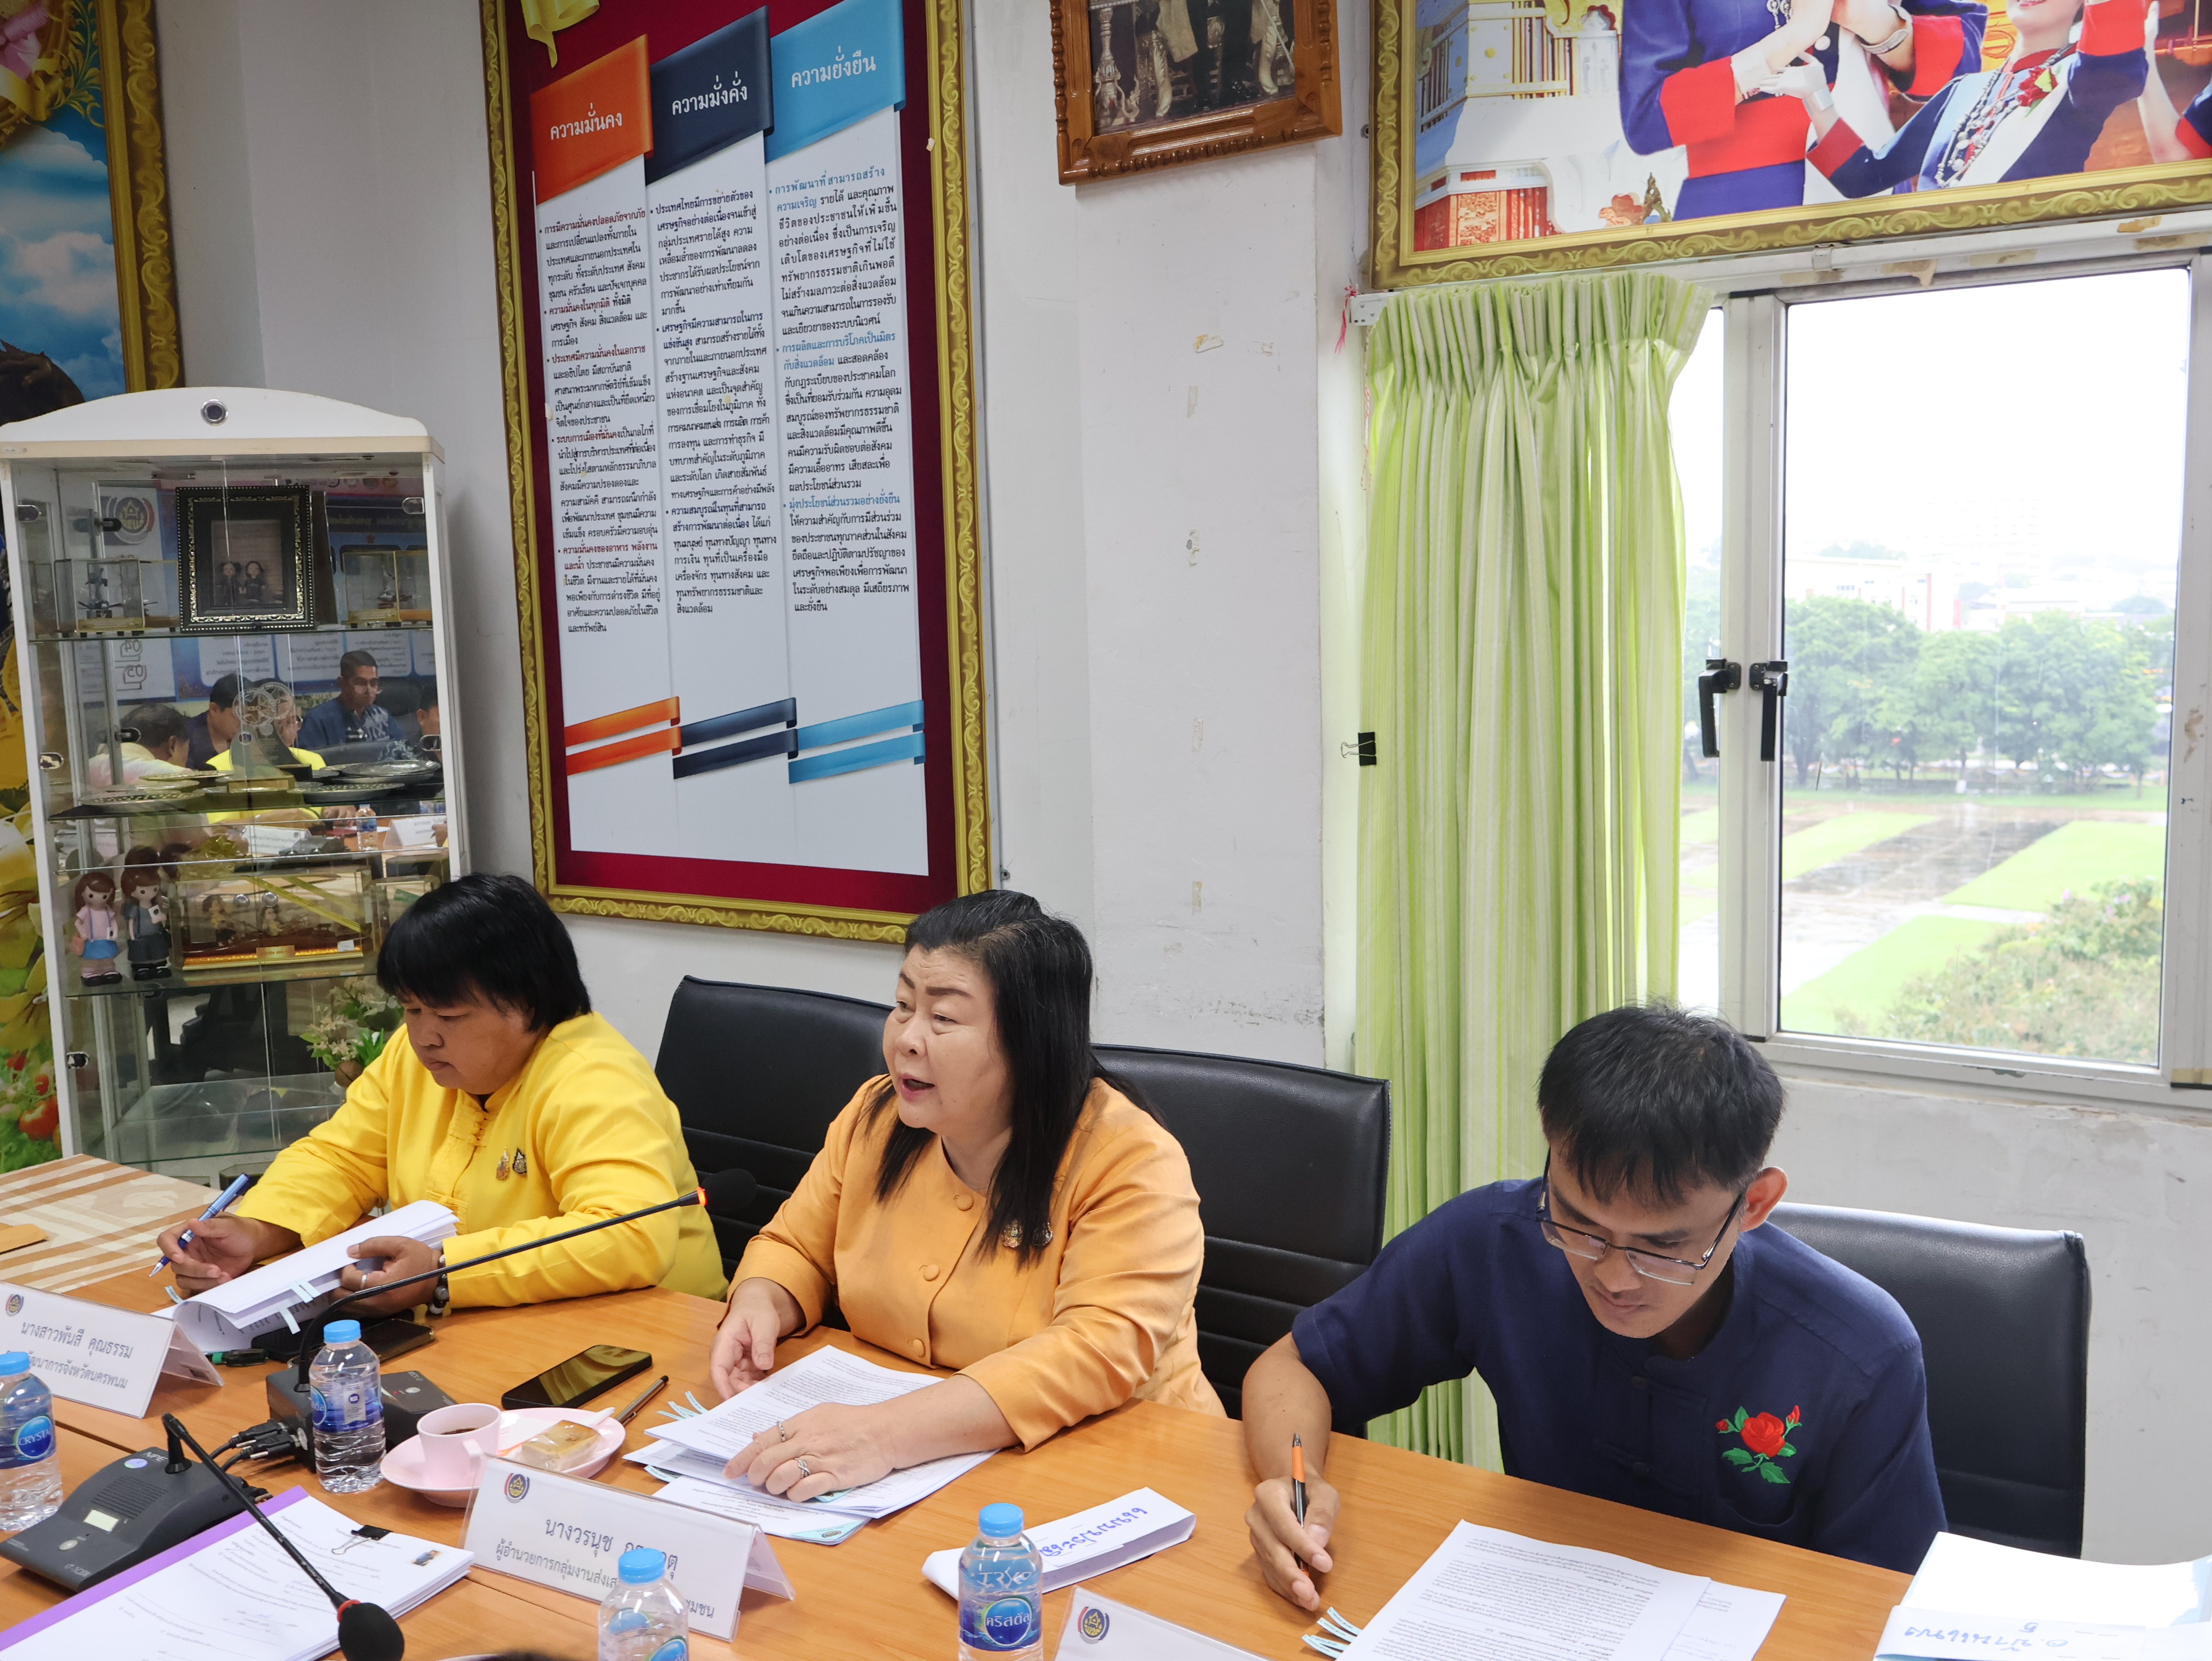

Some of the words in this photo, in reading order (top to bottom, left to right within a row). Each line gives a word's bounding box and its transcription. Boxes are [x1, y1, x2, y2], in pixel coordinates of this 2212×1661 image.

[792, 46, 876, 88] ความยั่งยืน
[673, 71, 747, 115] ความมั่งคั่ง
[551, 103, 622, 140] ความมั่นคง
[777, 196, 816, 212] ความเจริญ
[820, 189, 844, 204] รายได้
[848, 186, 893, 201] และคุณภาพ
[734, 226, 752, 236] ความ
[779, 227, 828, 247] อย่างต่อเนื่อง
[548, 269, 573, 286] ทุกระดับ
[575, 264, 624, 278] ทั้งระดับประเทศ
[627, 260, 645, 271] สังคม
[549, 290, 567, 302] ชุมชน
[569, 283, 595, 296] ครัวเรือน
[598, 278, 646, 292] และปัจเจกบุคคล
[612, 292, 631, 306] ทั้งมิติ
[662, 299, 685, 316] มากขึ้น
[551, 318, 577, 332] เศรษฐกิจ
[580, 317, 596, 327] สังคม
[599, 311, 632, 325] สิ่งแวดล้อม
[552, 335, 578, 347] การเมือง
[663, 337, 692, 350] แข่งขันสูง
[784, 355, 834, 370] กับสิ่งแวดล้อม
[838, 348, 888, 365] และสอดคล้อง
[554, 365, 589, 379] และอธิปไตย
[592, 361, 631, 376] มีสถาบันชาติ
[666, 388, 703, 399] แห่งอนาคต
[707, 380, 763, 397] และเป็นจุดสำคัญ
[866, 387, 901, 400] ความอุดม
[756, 393, 766, 407] ทั้ง
[556, 415, 610, 427] จิตใจของประชาชน
[668, 417, 721, 432] การคมนาคมขนส่ง
[724, 416, 748, 427] การผลิต
[751, 413, 770, 425] การค้า
[669, 440, 700, 451] การลงทุน
[703, 432, 755, 447] และการทำธุรกิจ
[759, 430, 764, 442] มี
[788, 458, 845, 474] มีความเอื้ออาทร
[849, 453, 890, 470] เสียสละเพื่อ
[670, 468, 712, 482] และระดับโลก
[715, 465, 767, 479] เกิดสายสัมพันธ์
[561, 494, 599, 507] ความสามัคคี
[602, 491, 656, 504] สามารถผนึกกำลัง
[617, 507, 656, 523] ชุมชนมีความ
[751, 515, 771, 527] ได้แก่
[563, 527, 585, 538] เข้มแข็ง
[631, 541, 658, 551] พลังงาน
[673, 536, 703, 552] ทุนมนุษย์
[705, 535, 750, 550] ทุนทางปัญญา
[753, 537, 776, 548] ทุนทาง
[565, 556, 585, 570] และน้ำ
[675, 554, 700, 564] การเงิน
[564, 574, 584, 586] ในชีวิต
[675, 566, 707, 581] เครื่องจักร
[710, 568, 753, 583] ทุนทางสังคม
[641, 585, 660, 602] มีที่อยู่
[863, 581, 909, 593] มีเสถียรภาพ
[677, 602, 712, 613] สิ่งแวดล้อม
[795, 597, 827, 611] และยั่งยืน
[568, 622, 607, 632] และทรัพย์สิน
[88, 1337, 133, 1359] คุณธรรม
[545, 1519, 614, 1558] นางวรนุช
[986, 1612, 1030, 1627] คริสตัล
